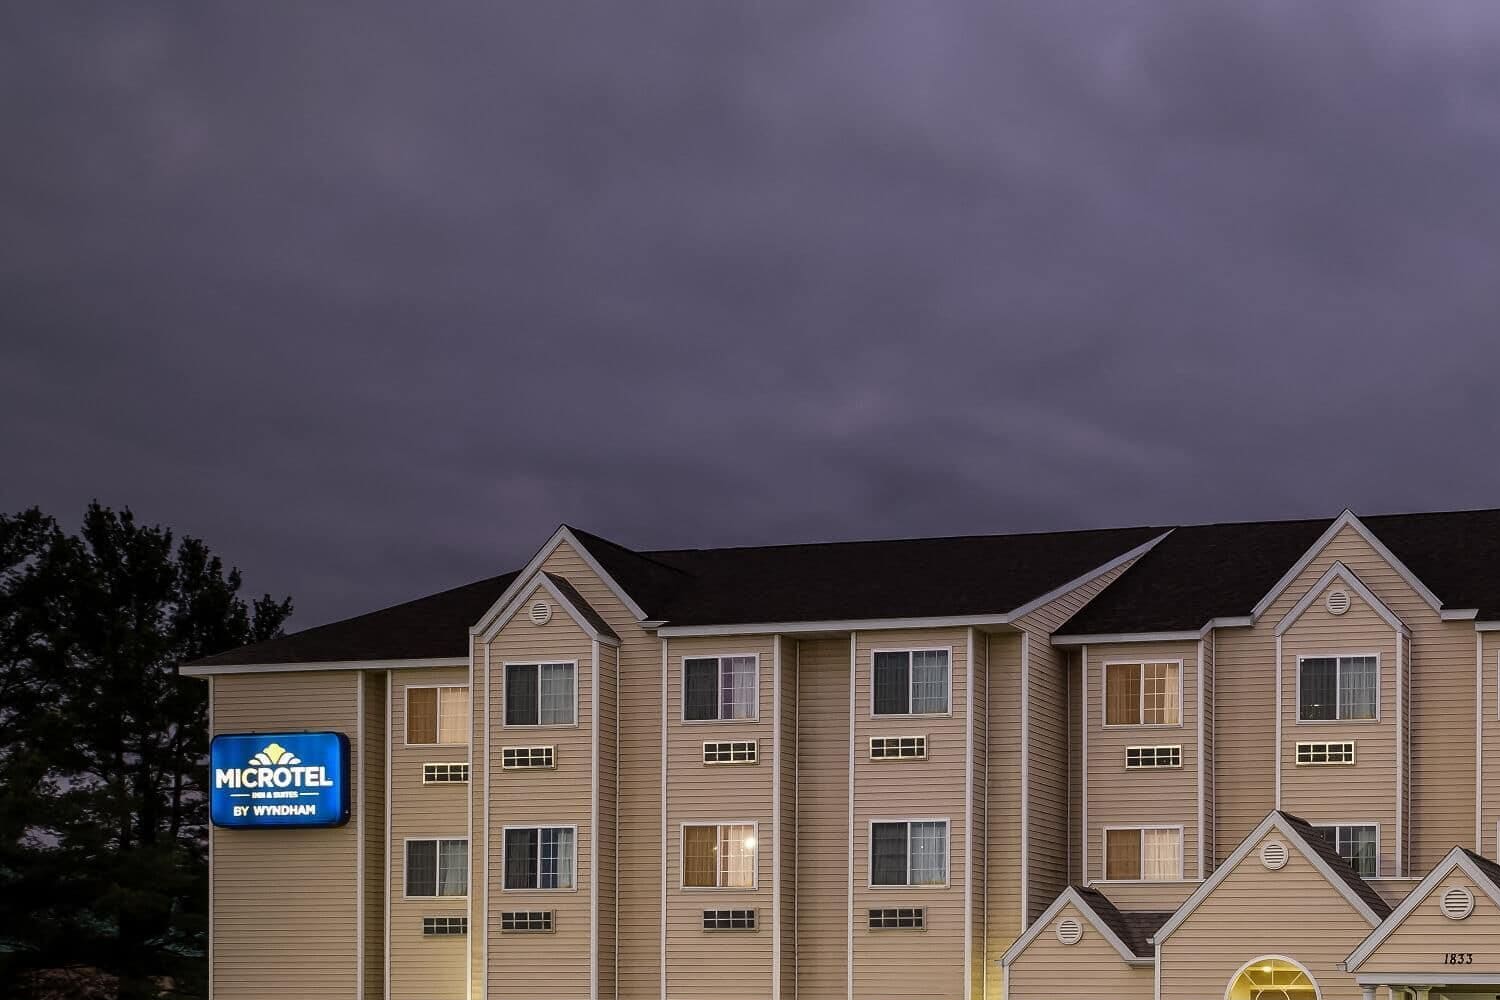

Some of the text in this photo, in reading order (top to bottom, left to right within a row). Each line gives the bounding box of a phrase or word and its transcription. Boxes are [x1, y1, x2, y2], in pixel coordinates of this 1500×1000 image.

[215, 766, 334, 788] MICROTEL
[233, 804, 316, 817] BY WYNDHAM
[1444, 953, 1473, 965] 1833
